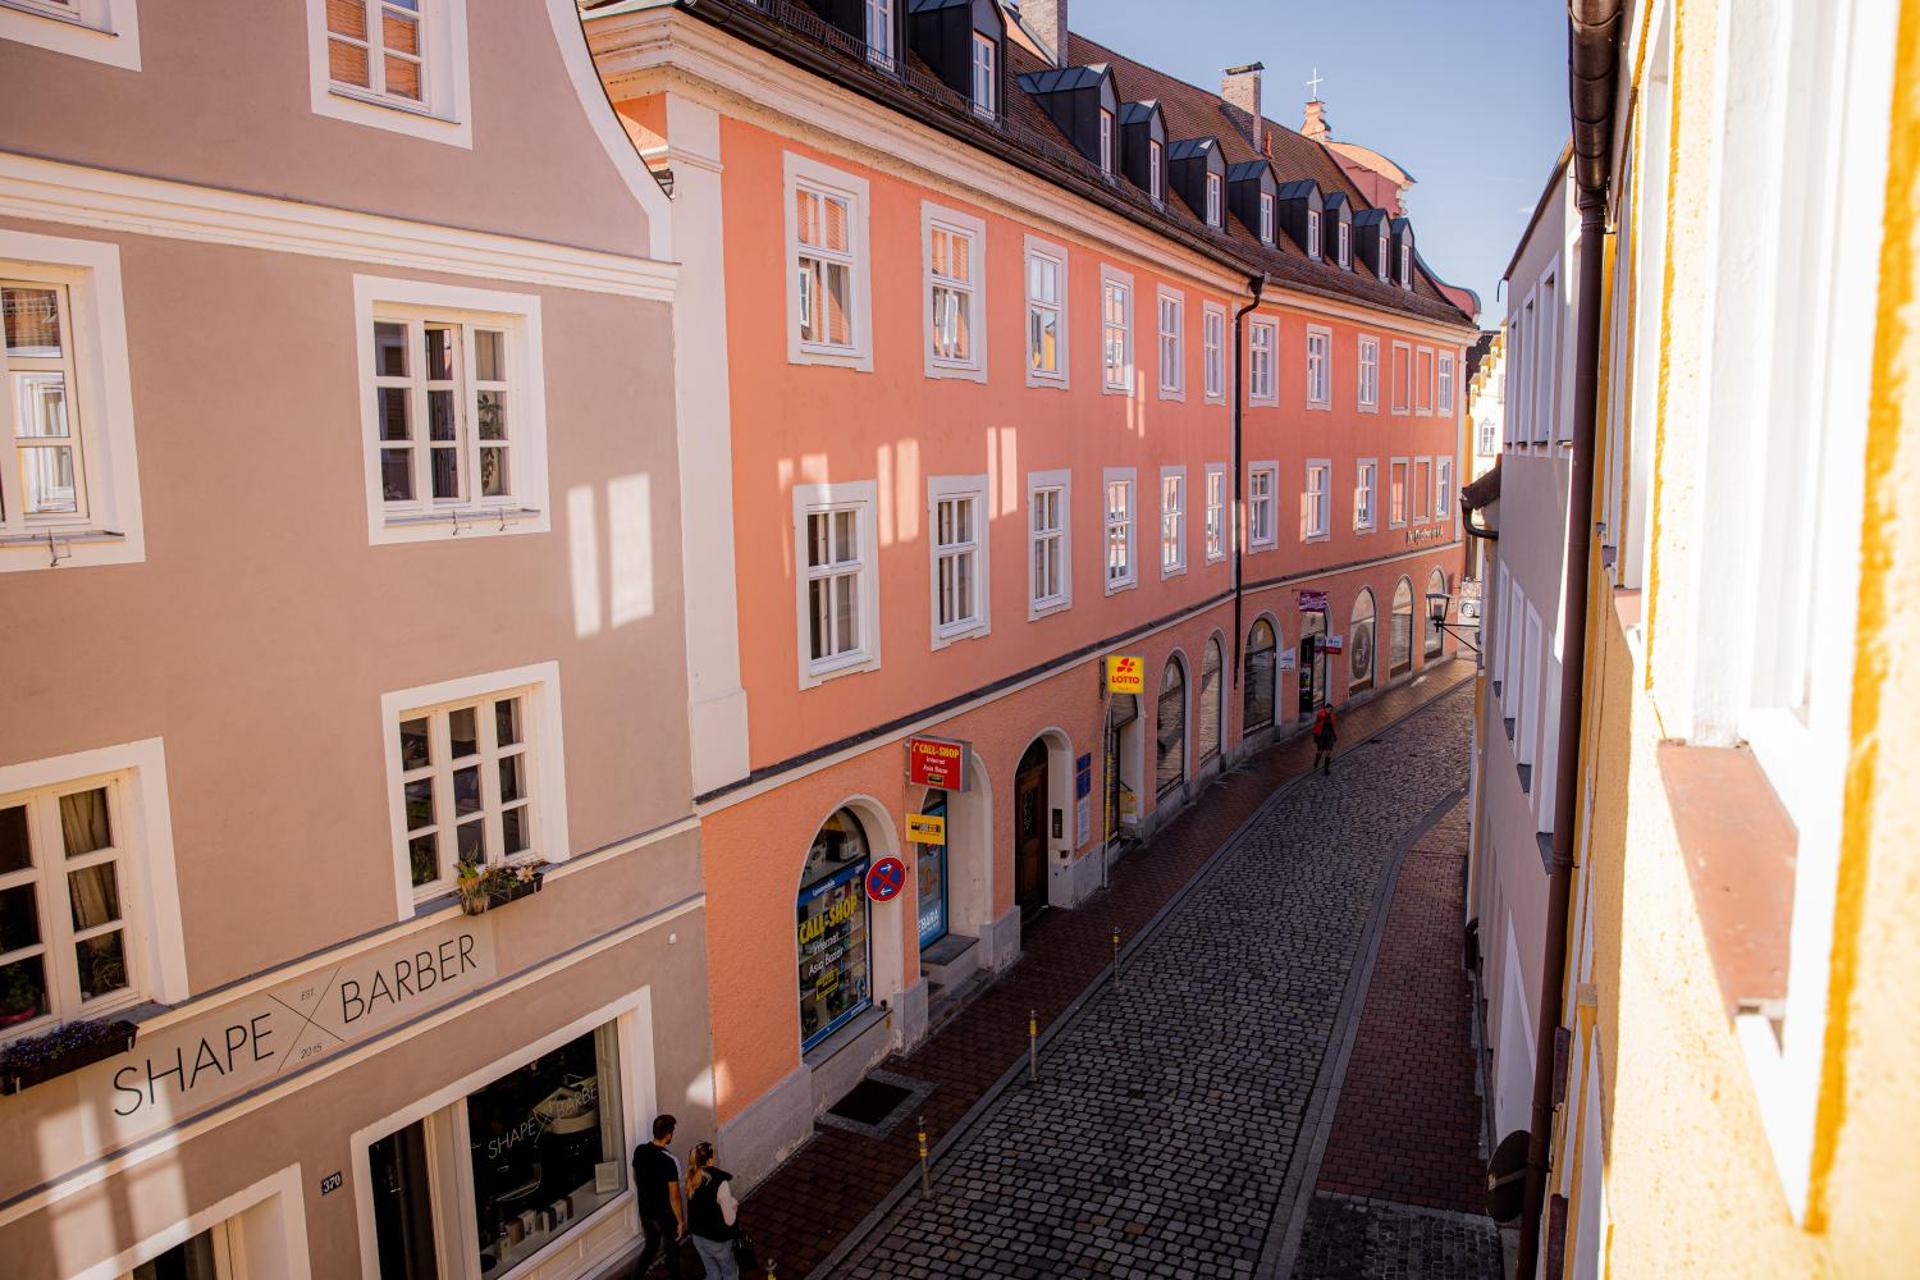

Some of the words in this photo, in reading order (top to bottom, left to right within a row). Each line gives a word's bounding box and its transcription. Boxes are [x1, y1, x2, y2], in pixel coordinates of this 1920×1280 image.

[1111, 675, 1140, 684] LOTTO
[919, 744, 960, 759] CALL-SHOP
[799, 894, 858, 945] CALL-SHOP
[809, 961, 824, 976] Asia
[113, 1012, 275, 1116] SHAPE
[341, 934, 477, 1024] BARBER
[301, 1043, 323, 1059] 2015
[488, 1116, 536, 1159] SHAPE
[324, 1174, 340, 1192] 370
